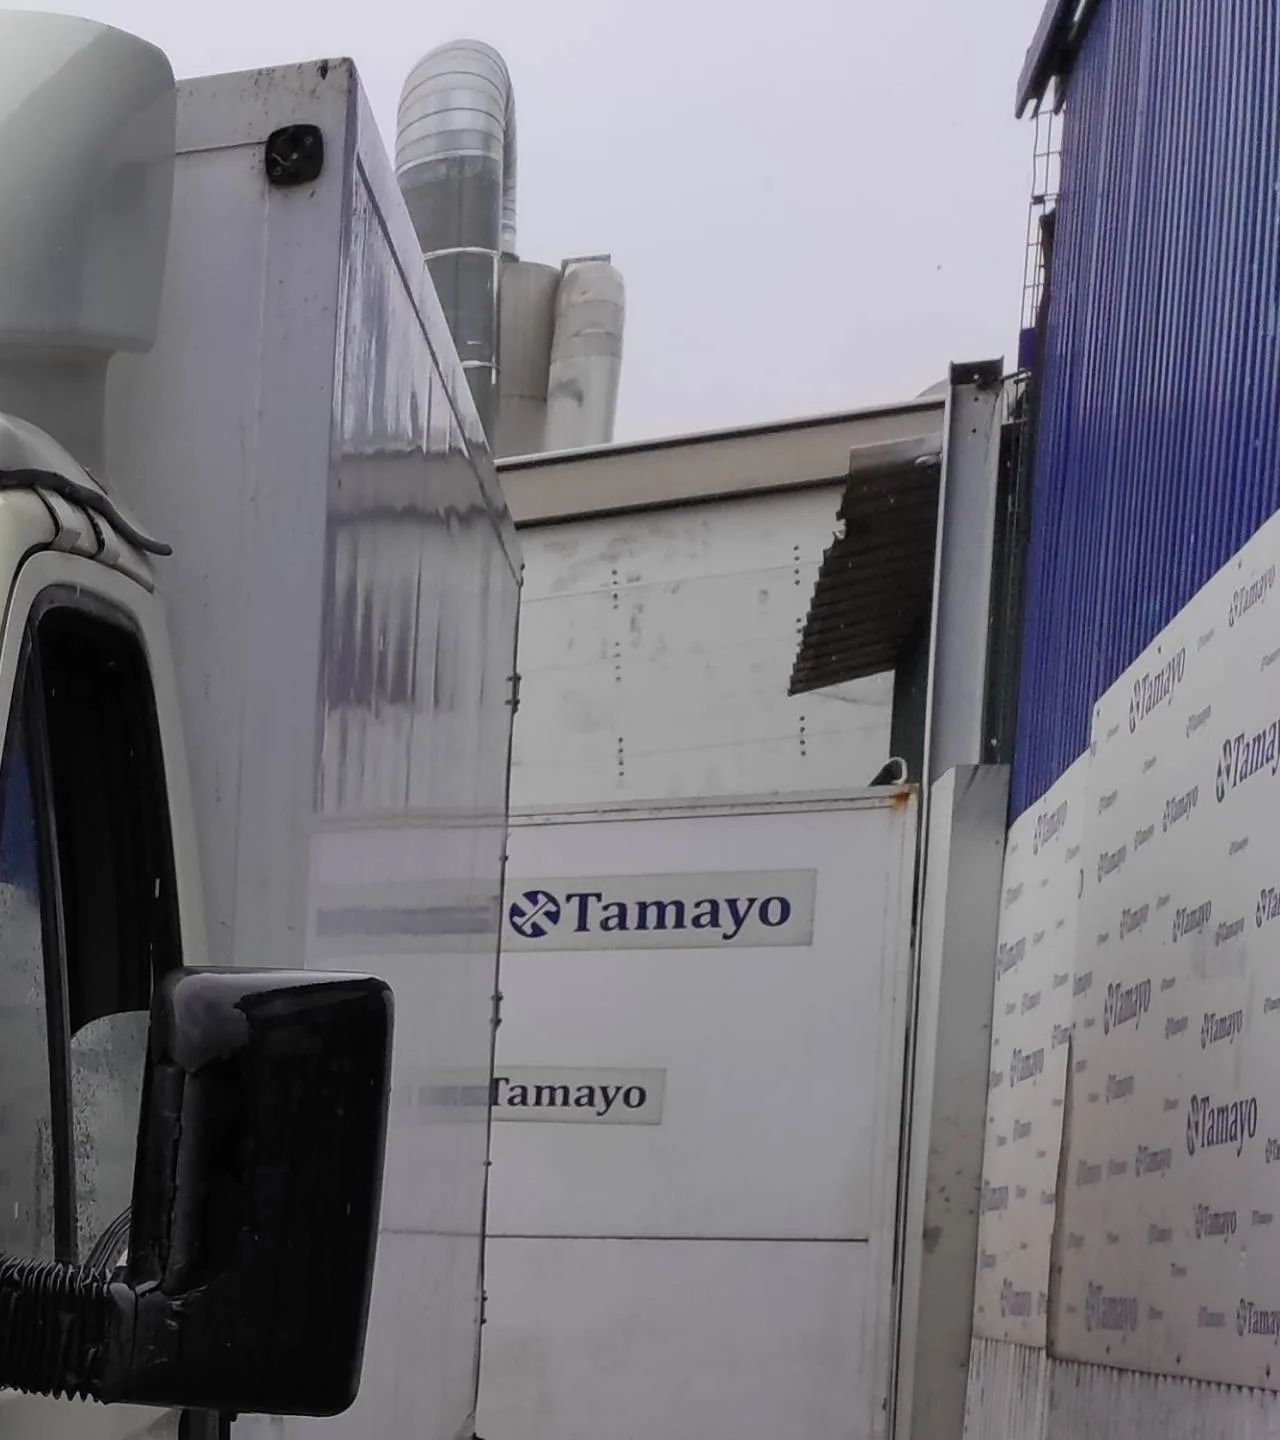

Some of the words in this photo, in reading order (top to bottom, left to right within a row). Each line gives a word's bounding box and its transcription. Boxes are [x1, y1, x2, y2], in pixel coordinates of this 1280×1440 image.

[1238, 565, 1276, 617] Tamayo
[1140, 647, 1186, 721] Tamayo
[565, 892, 792, 940] Tamayo
[1209, 1010, 1243, 1045] Tamayo
[490, 1076, 647, 1116] Tamayo
[1200, 1096, 1258, 1159] Tamayo
